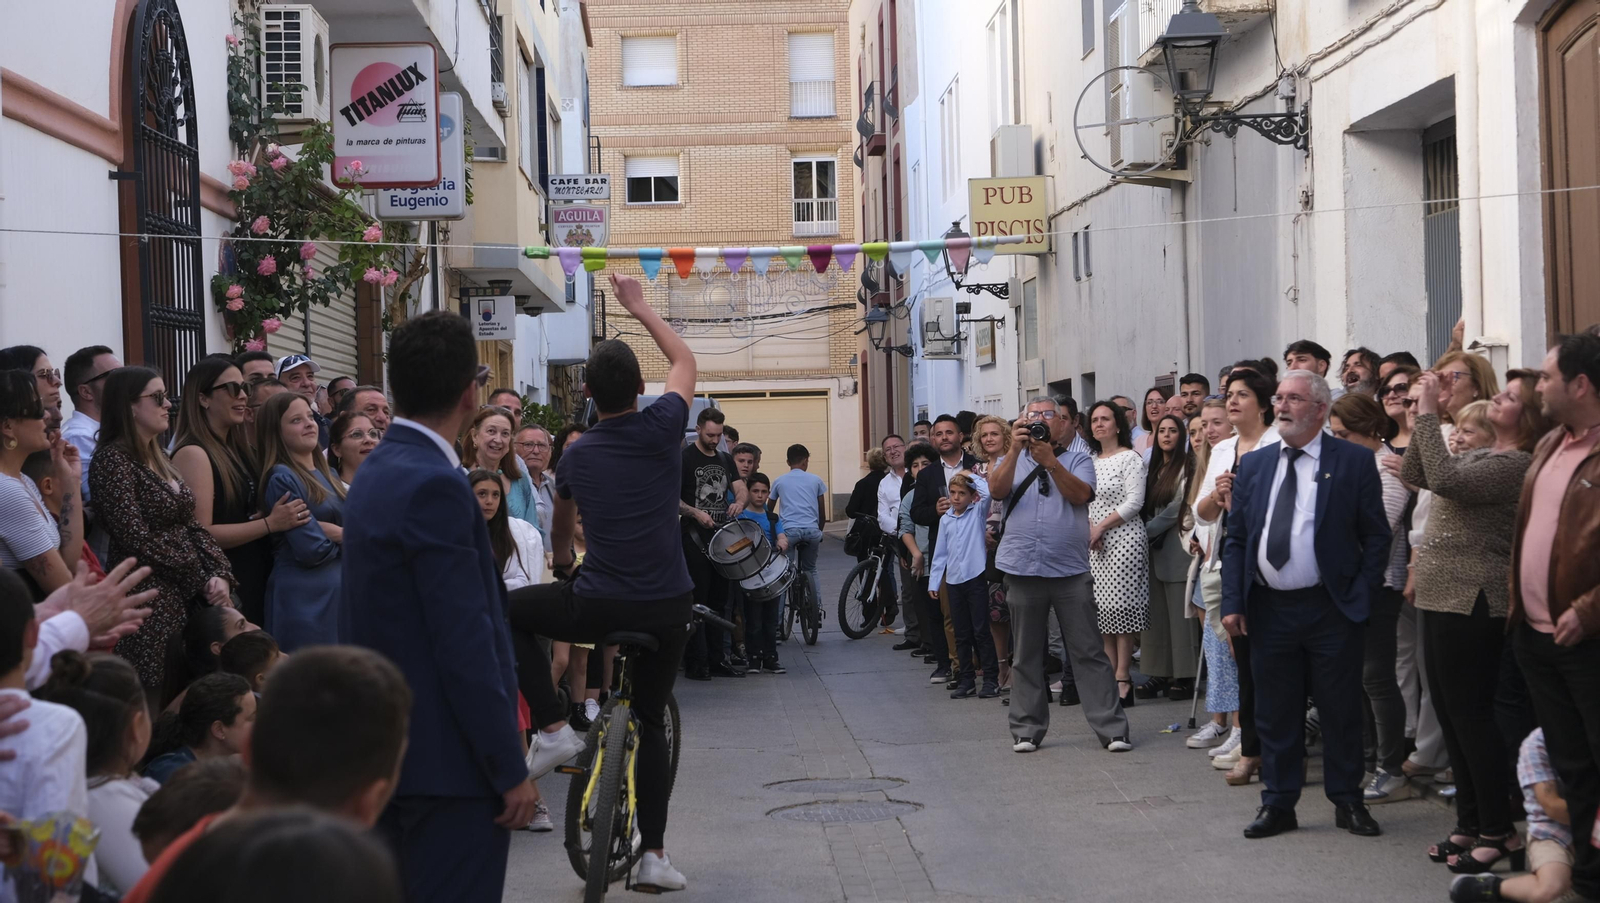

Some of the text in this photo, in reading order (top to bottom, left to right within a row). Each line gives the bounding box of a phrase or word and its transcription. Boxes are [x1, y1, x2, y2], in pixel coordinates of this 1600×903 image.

[339, 62, 427, 127] TITANLUX
[383, 138, 393, 146] de
[395, 137, 426, 146] pinturas
[554, 186, 604, 195] MONTECARLO
[982, 185, 1033, 205] PUB
[390, 193, 448, 210] Eugenio
[558, 210, 601, 222] AGUILA
[975, 219, 1044, 244] PISCIS
